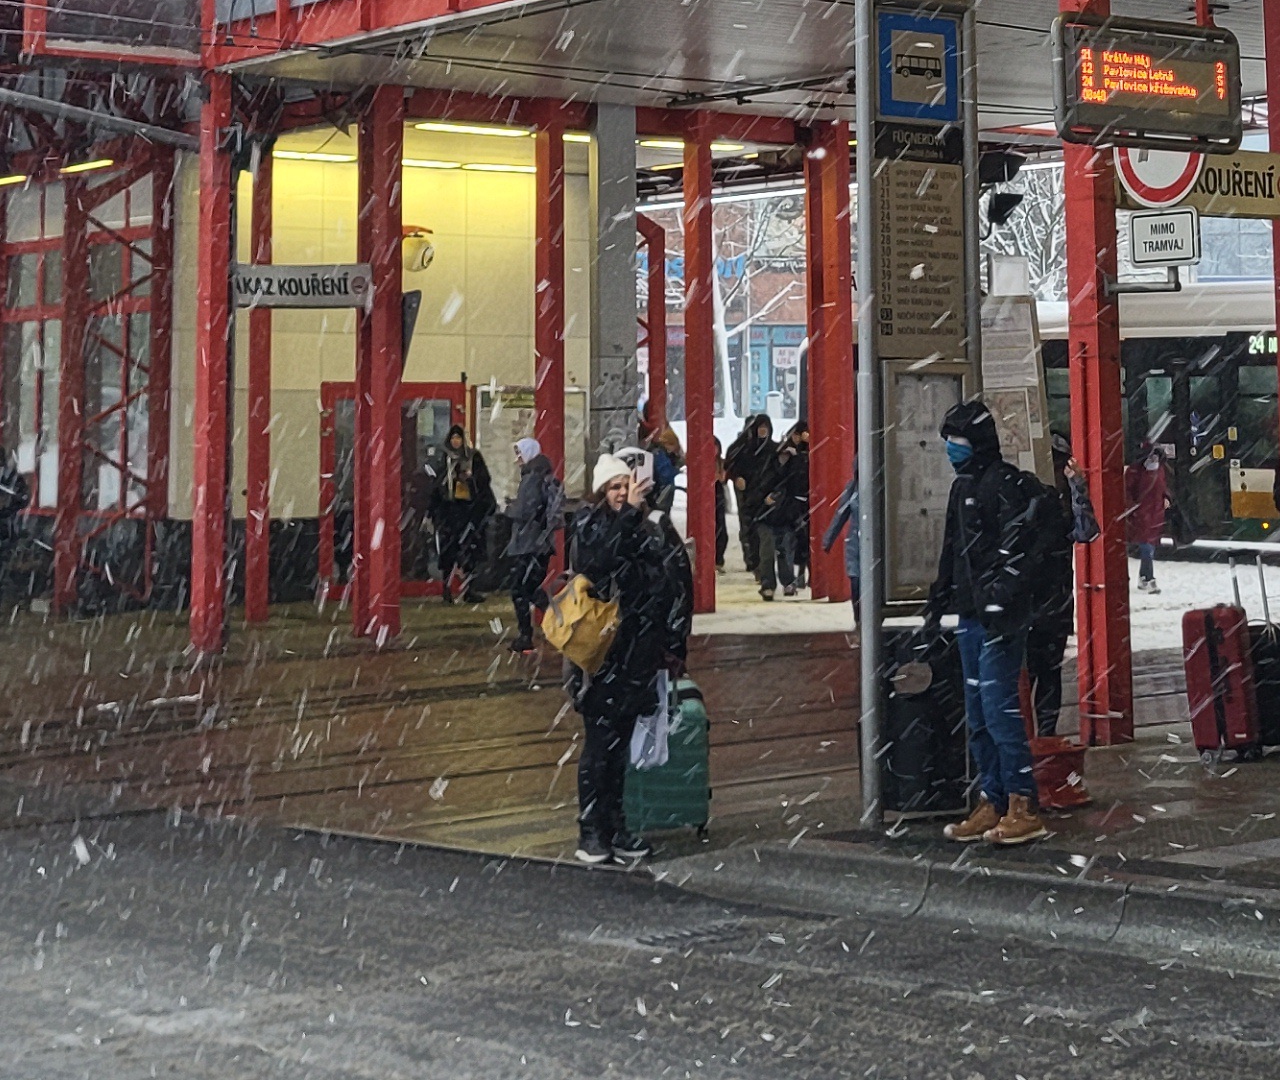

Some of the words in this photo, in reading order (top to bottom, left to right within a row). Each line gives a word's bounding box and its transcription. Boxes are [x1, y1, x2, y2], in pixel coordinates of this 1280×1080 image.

[1082, 63, 1092, 73] 12
[1216, 63, 1223, 73] 2
[881, 188, 890, 198] 21
[881, 211, 890, 222] 24
[881, 223, 891, 233] 26
[1150, 222, 1175, 235] MIMO
[881, 234, 891, 245] 28
[1143, 239, 1184, 253] TRAMVAJ
[278, 272, 349, 296] KOUŘENÍ
[881, 282, 891, 292] 51
[881, 293, 891, 305] 52
[1248, 335, 1265, 354] 24
